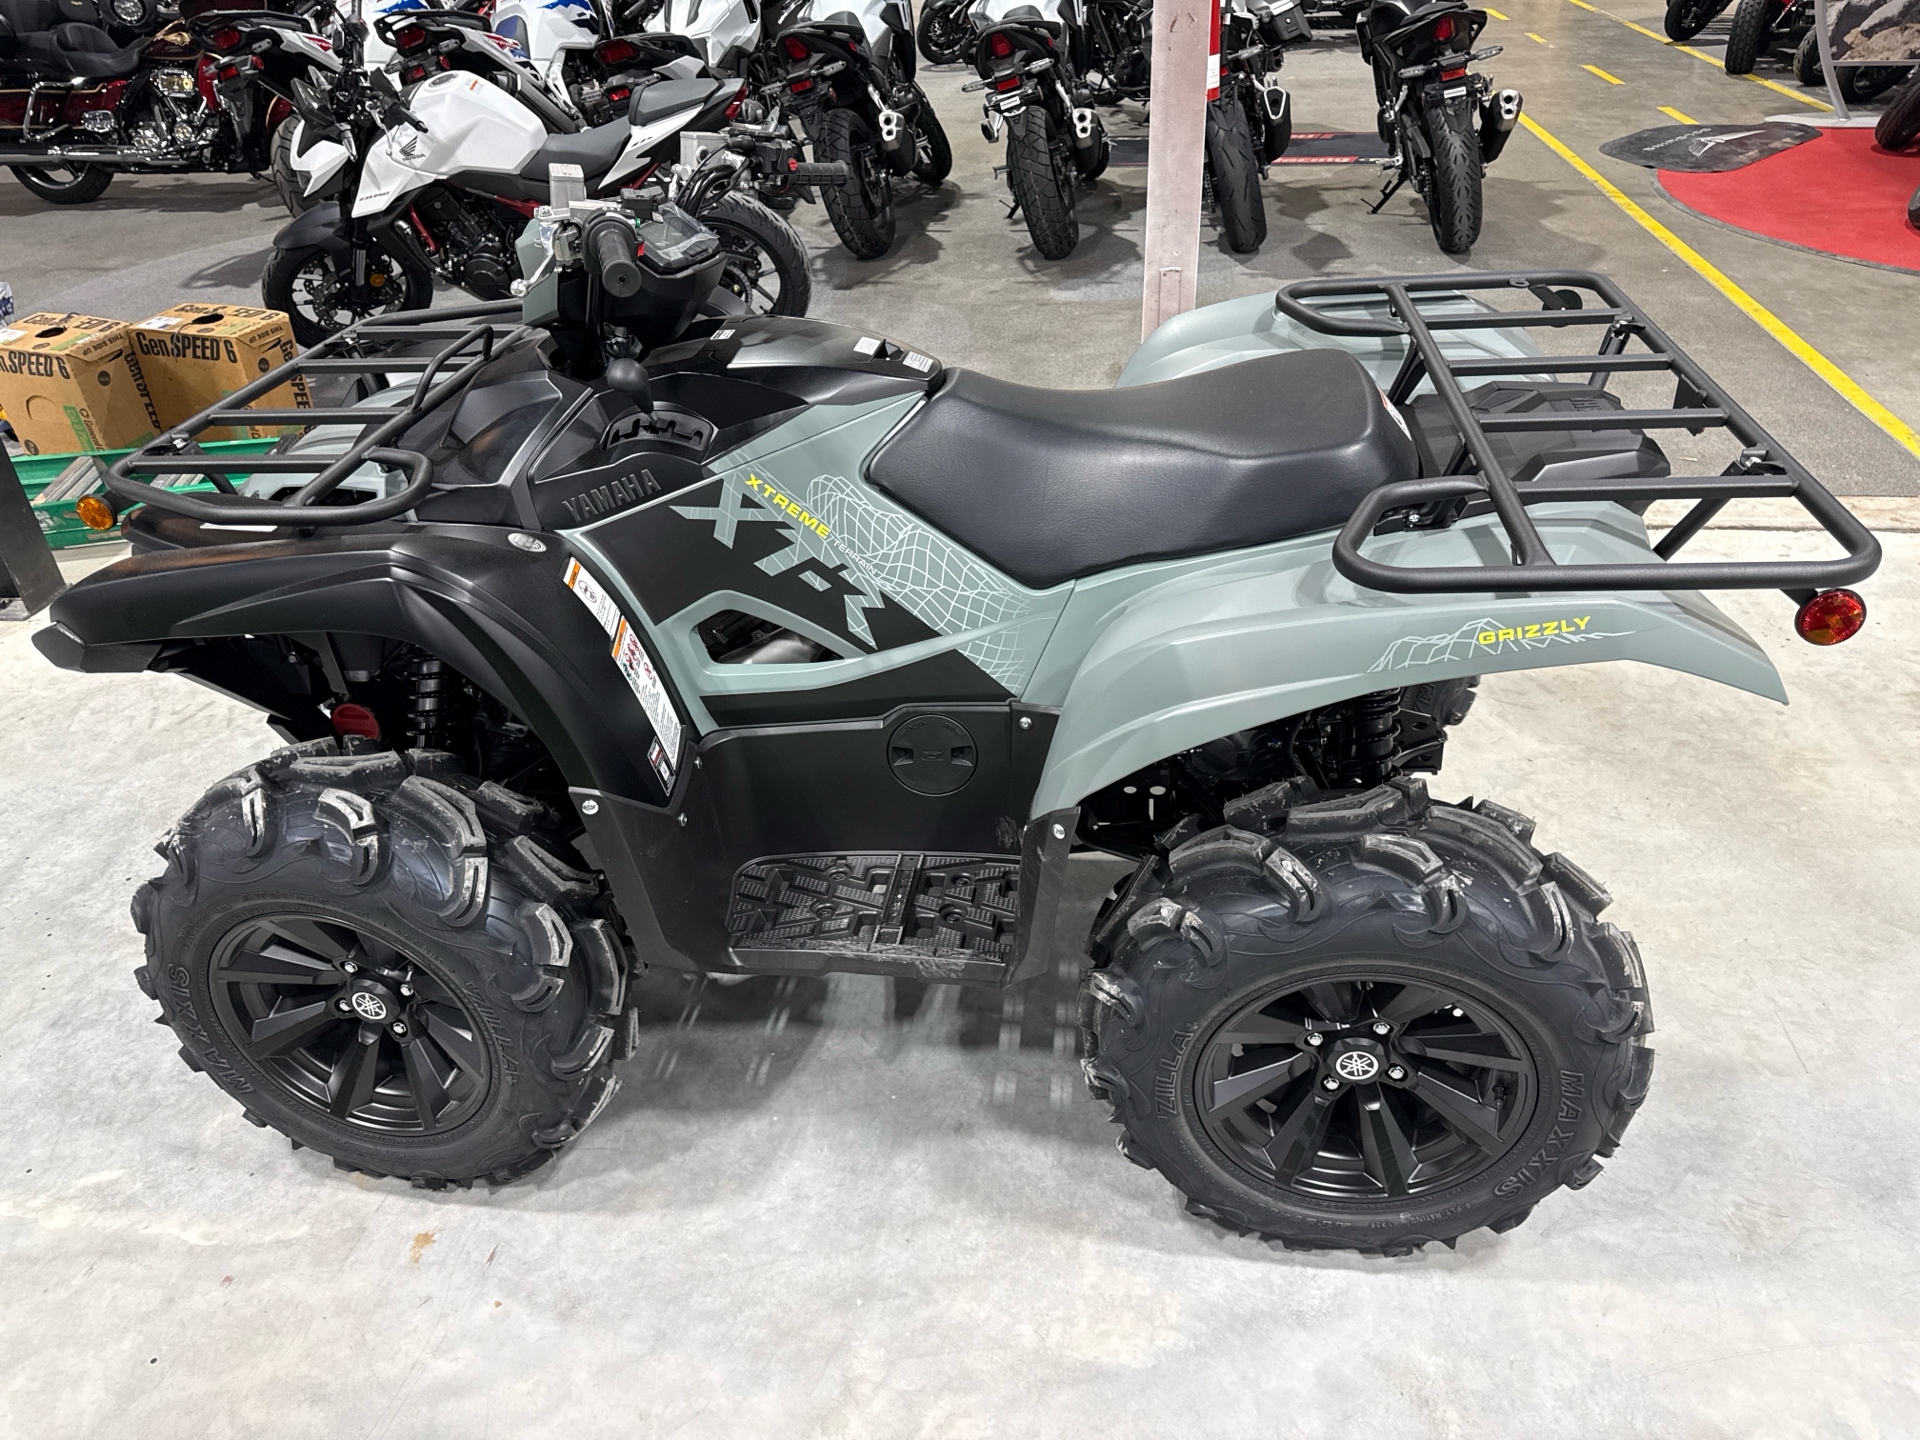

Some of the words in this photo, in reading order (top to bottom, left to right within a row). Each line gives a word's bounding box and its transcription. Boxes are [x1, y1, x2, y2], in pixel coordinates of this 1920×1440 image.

[402, 153, 426, 161] HONDA
[55, 356, 71, 380] 6
[223, 339, 238, 364] 6
[562, 468, 662, 523] YAMAHA
[745, 474, 831, 539] XTREME
[832, 538, 878, 575] TERRAIN
[1478, 615, 1591, 645] GRIZZLY
[168, 963, 255, 1094] MAXXIS
[462, 986, 520, 1075] ZILLA
[1154, 1030, 1195, 1114] ZILLA
[1493, 1069, 1586, 1199] MAXXIS
[1410, 1212, 1442, 1225] RATING
[1445, 1206, 1463, 1216] PLY
